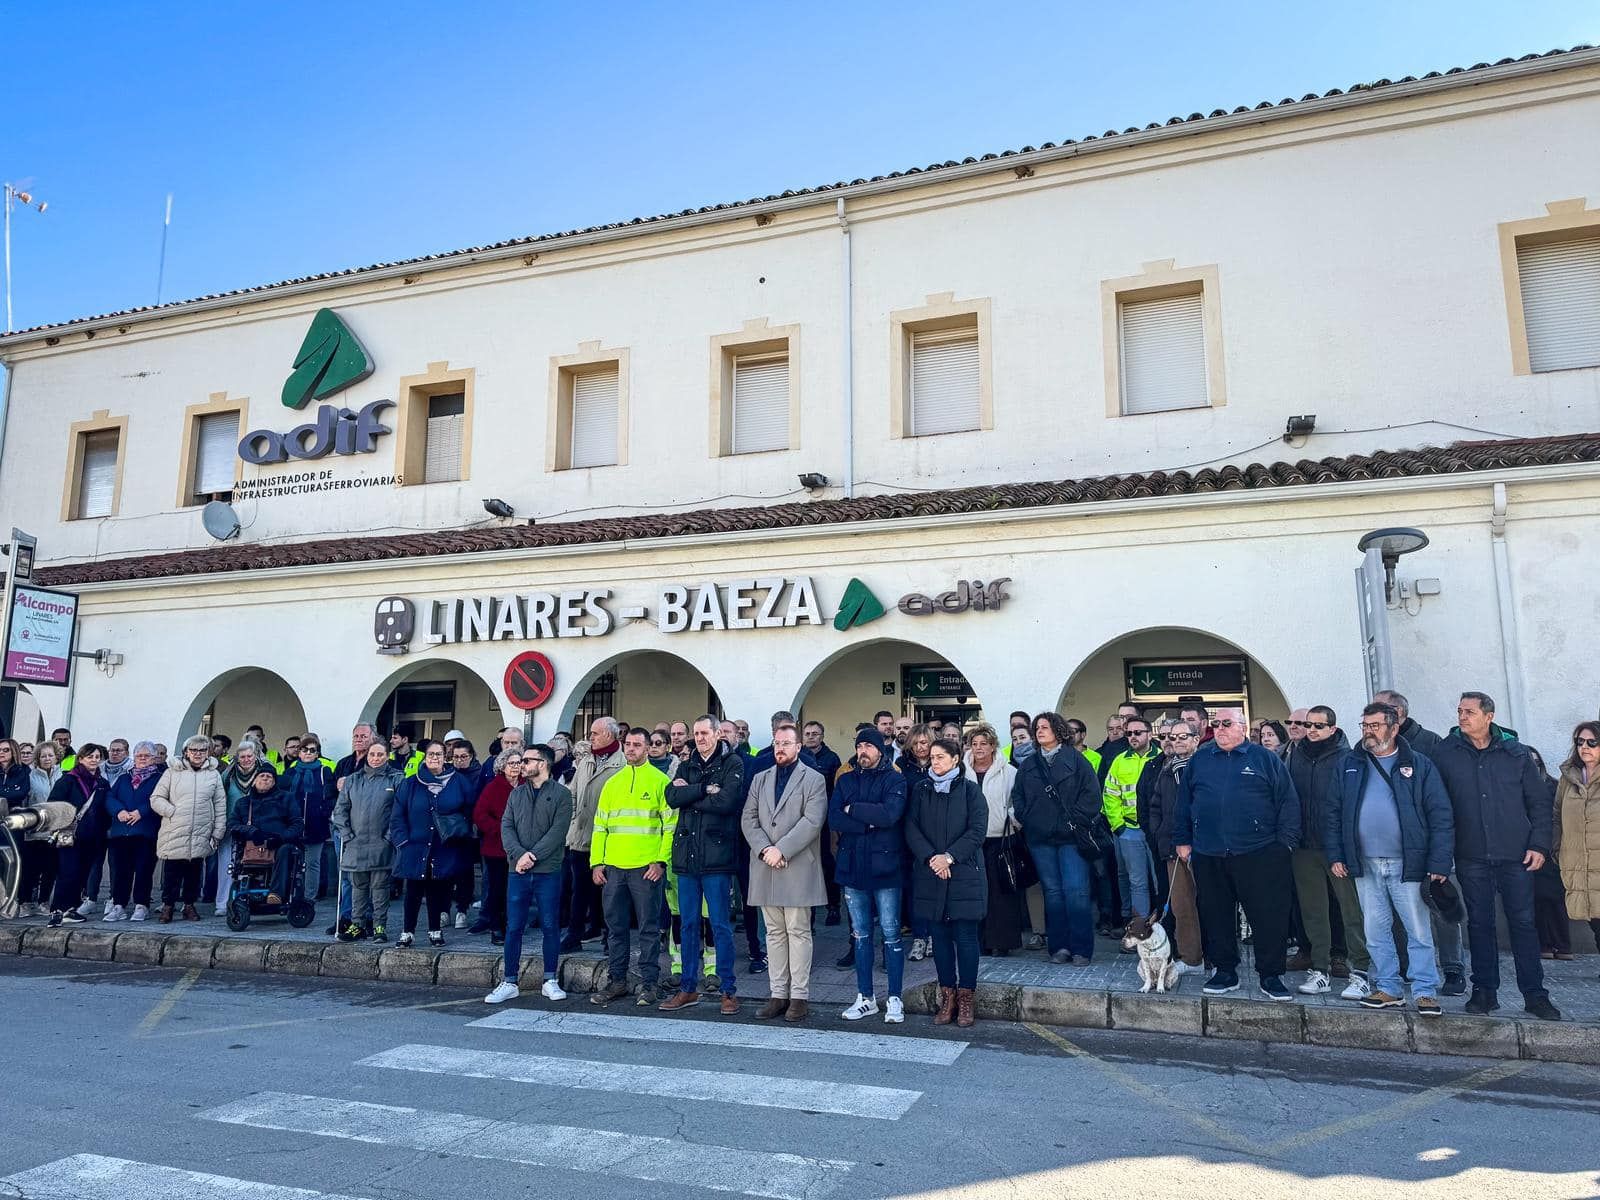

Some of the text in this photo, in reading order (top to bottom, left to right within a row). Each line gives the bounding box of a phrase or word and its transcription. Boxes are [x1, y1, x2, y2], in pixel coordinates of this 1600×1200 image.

[238, 399, 397, 465] adif
[233, 470, 333, 490] ADMINISTRADOR DE
[15, 592, 74, 616] Alcampo
[422, 590, 614, 644] LINARES
[659, 575, 824, 633] BAEZA
[898, 577, 1013, 616] adif
[1168, 671, 1203, 679] Entrada
